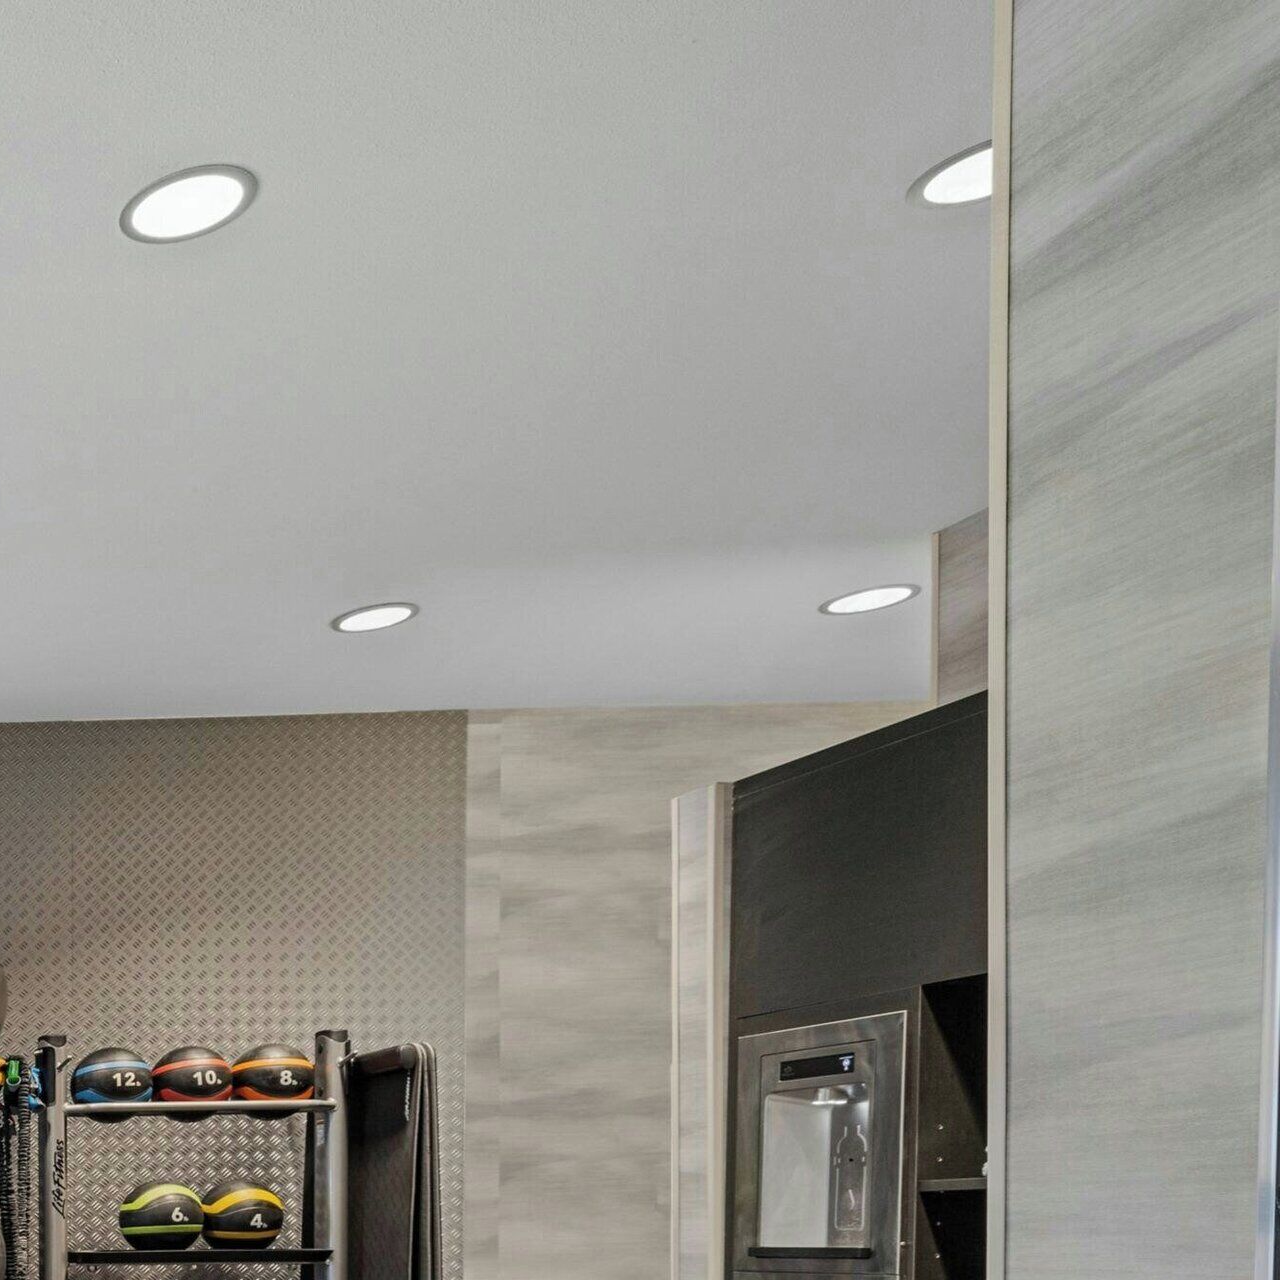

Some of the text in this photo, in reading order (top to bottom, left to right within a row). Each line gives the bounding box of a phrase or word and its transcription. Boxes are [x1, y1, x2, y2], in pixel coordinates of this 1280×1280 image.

[112, 1071, 136, 1087] 12
[192, 1069, 217, 1086] 10
[280, 1070, 292, 1085] 8
[171, 1206, 184, 1222] 6
[250, 1213, 263, 1228] 4
